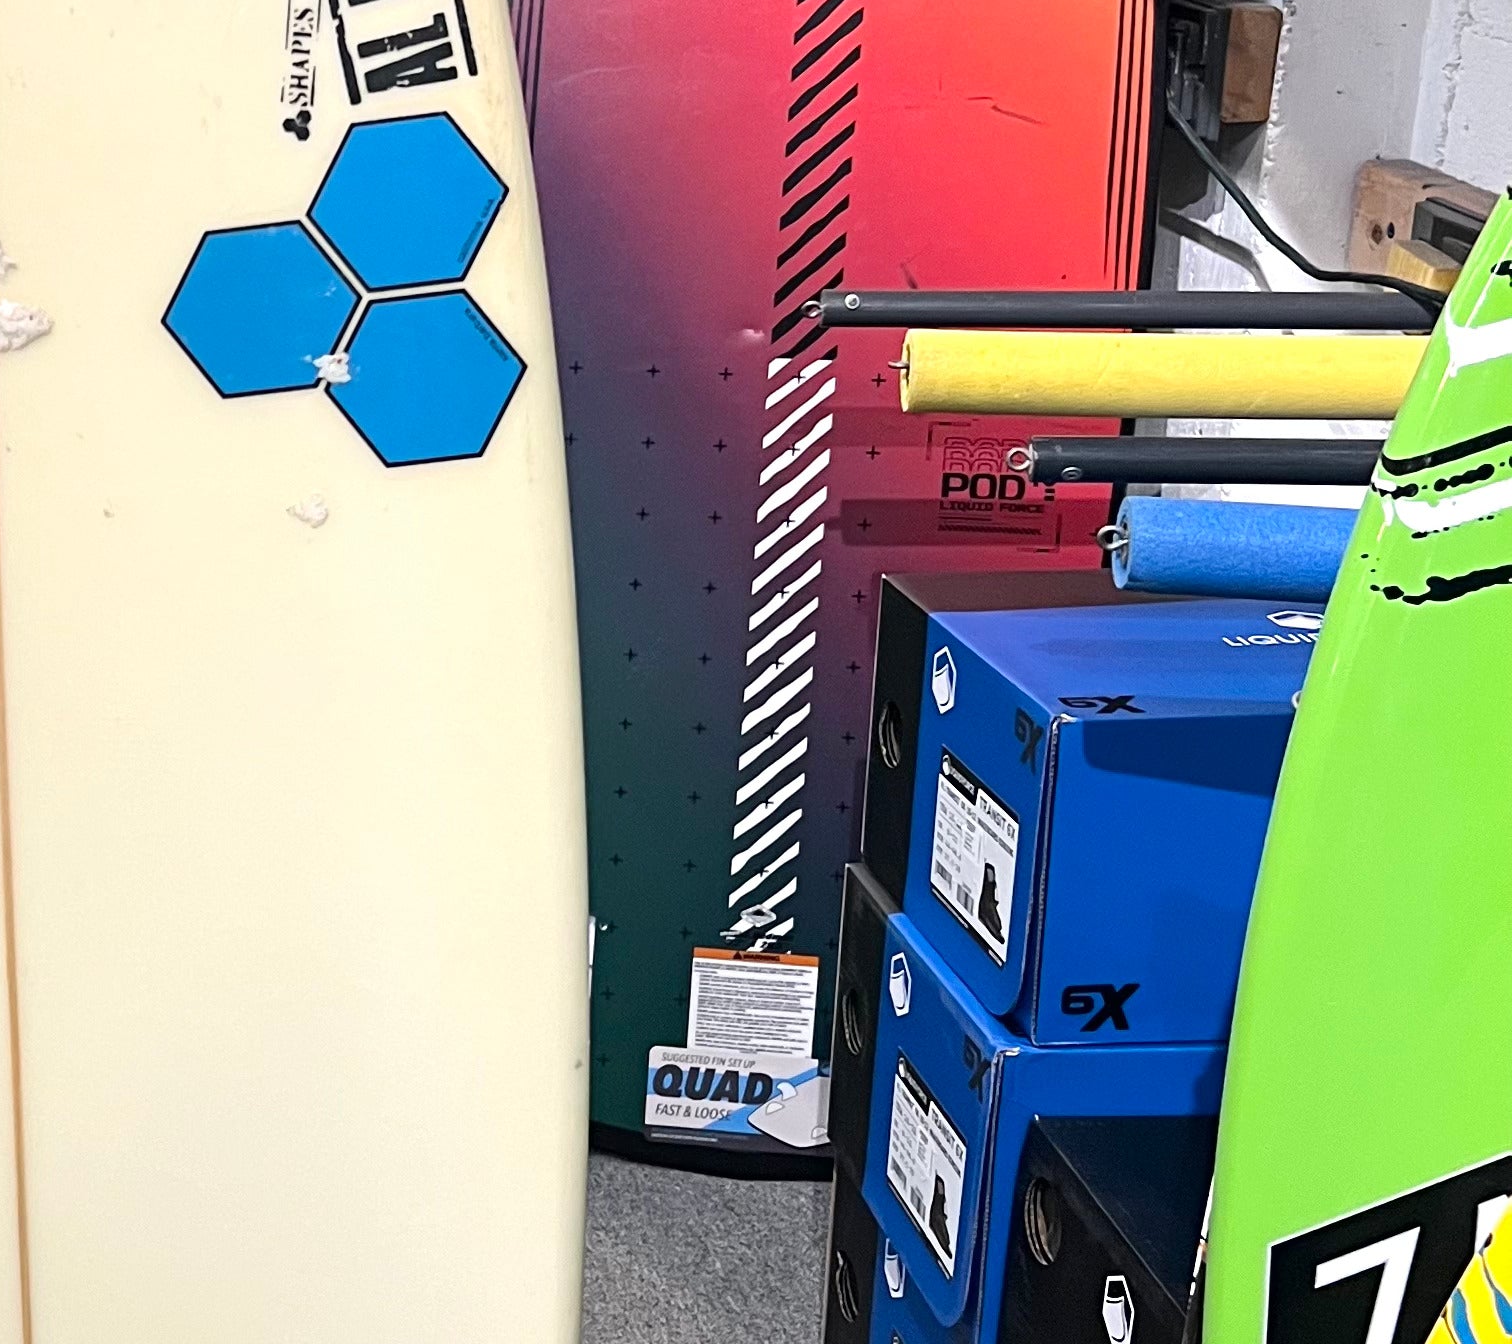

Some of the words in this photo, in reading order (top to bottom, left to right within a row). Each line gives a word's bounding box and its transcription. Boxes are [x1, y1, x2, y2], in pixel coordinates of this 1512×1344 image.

[289, 7, 315, 107] SHAPES
[357, 12, 458, 93] AL
[941, 472, 1026, 501] POD
[939, 500, 993, 512] LIQUID
[1061, 983, 1141, 1032] 6X
[661, 1052, 710, 1066] SUGGESTED
[711, 1055, 726, 1066] FIN
[728, 1057, 743, 1069] SET
[743, 1059, 756, 1069] UP
[652, 1064, 773, 1105] QUAD
[655, 1103, 681, 1117] FAST
[682, 1106, 691, 1118] &
[694, 1106, 732, 1121] LOOSE
